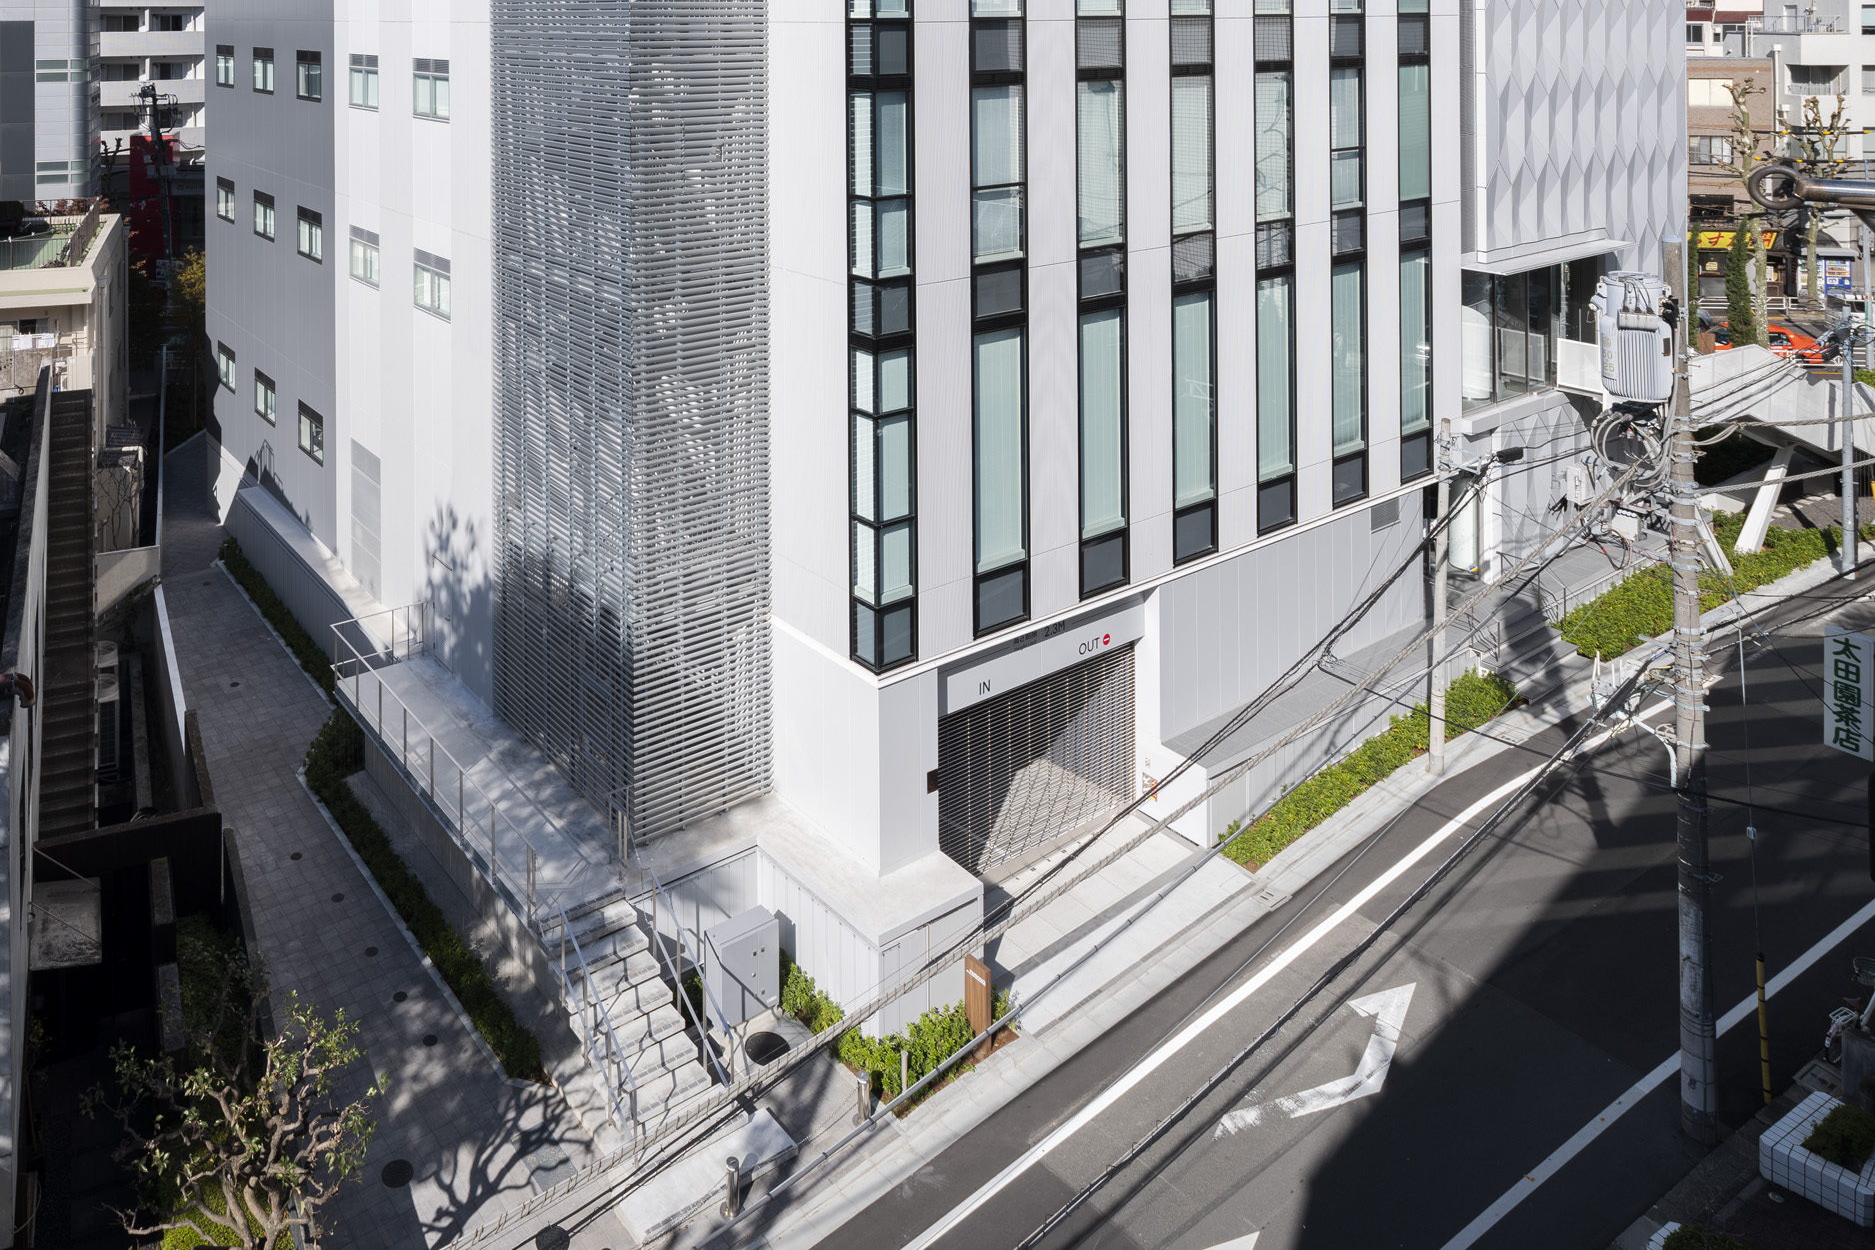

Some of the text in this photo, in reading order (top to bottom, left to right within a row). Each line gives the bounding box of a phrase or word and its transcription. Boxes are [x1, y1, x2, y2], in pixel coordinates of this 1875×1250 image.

[1044, 620, 1066, 637] 2.3M
[1078, 637, 1101, 656] OUT
[978, 679, 991, 696] IN
[1832, 637, 1862, 753] 太田園茶店
